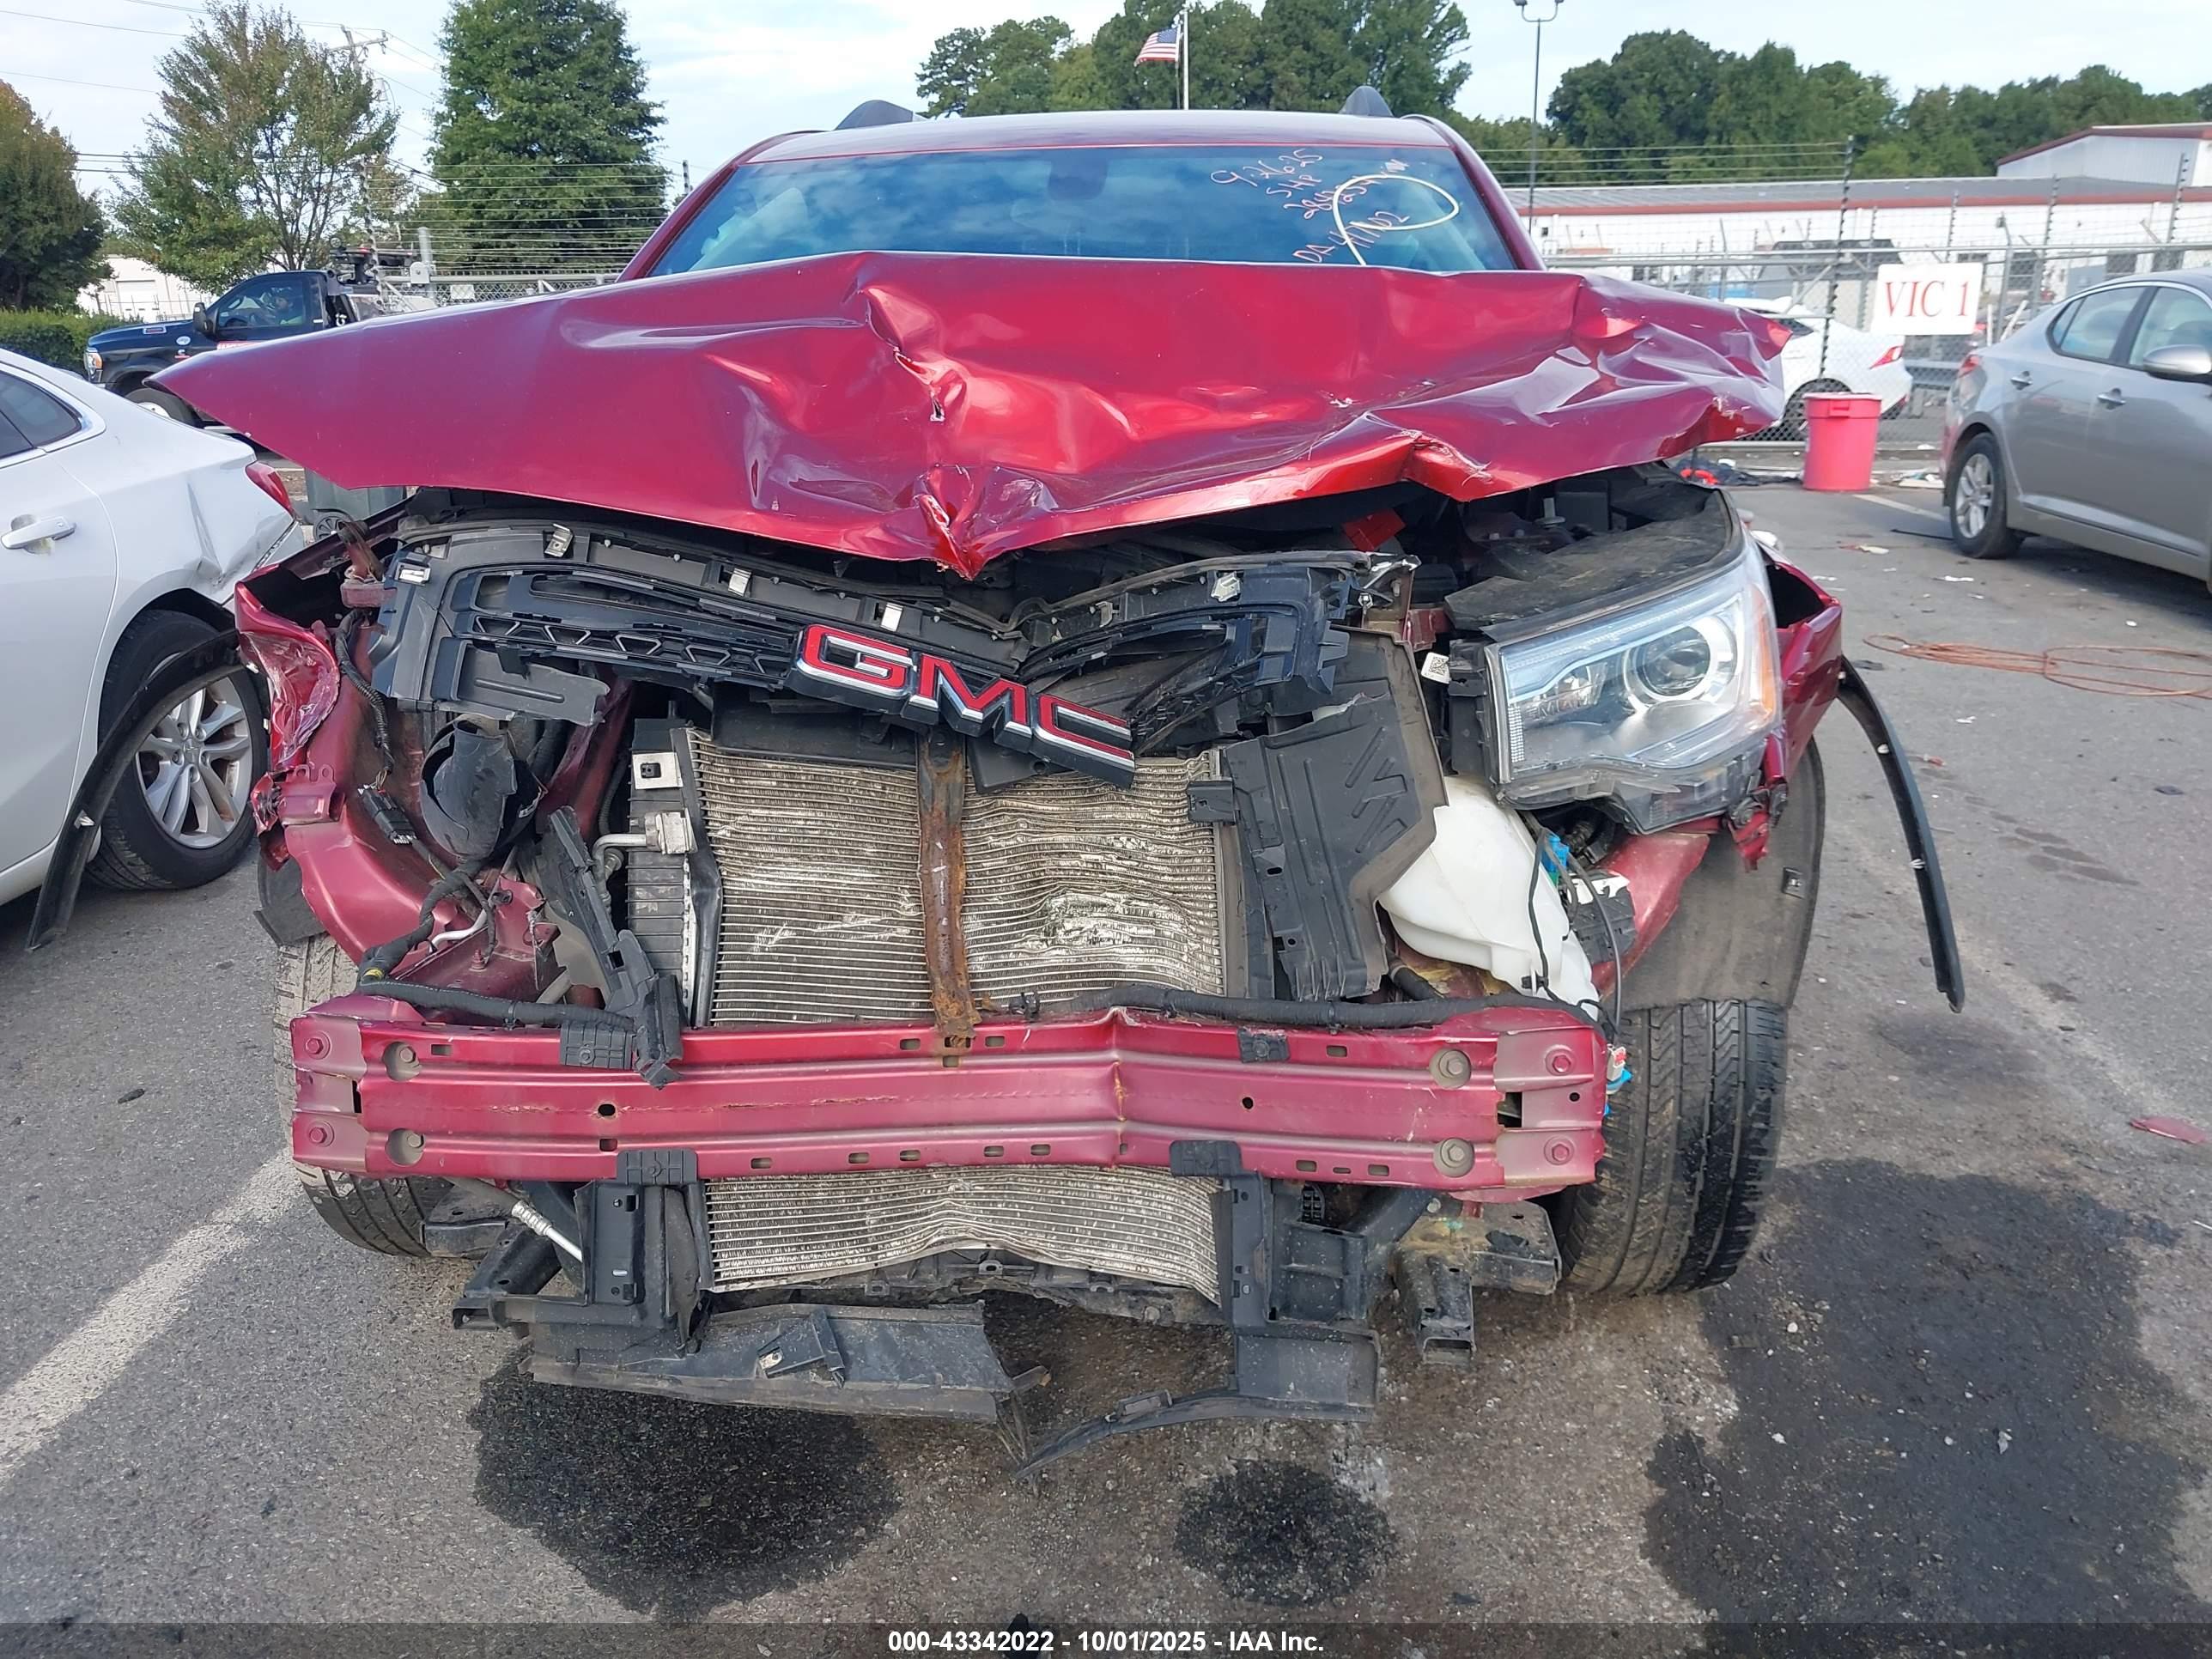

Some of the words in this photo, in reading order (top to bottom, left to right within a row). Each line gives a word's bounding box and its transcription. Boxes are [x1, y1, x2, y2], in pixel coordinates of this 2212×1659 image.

[1266, 174, 1322, 198] SHP
[1884, 280, 1945, 318] VIC
[1957, 280, 1970, 317] 1
[793, 623, 1136, 780] GMC
